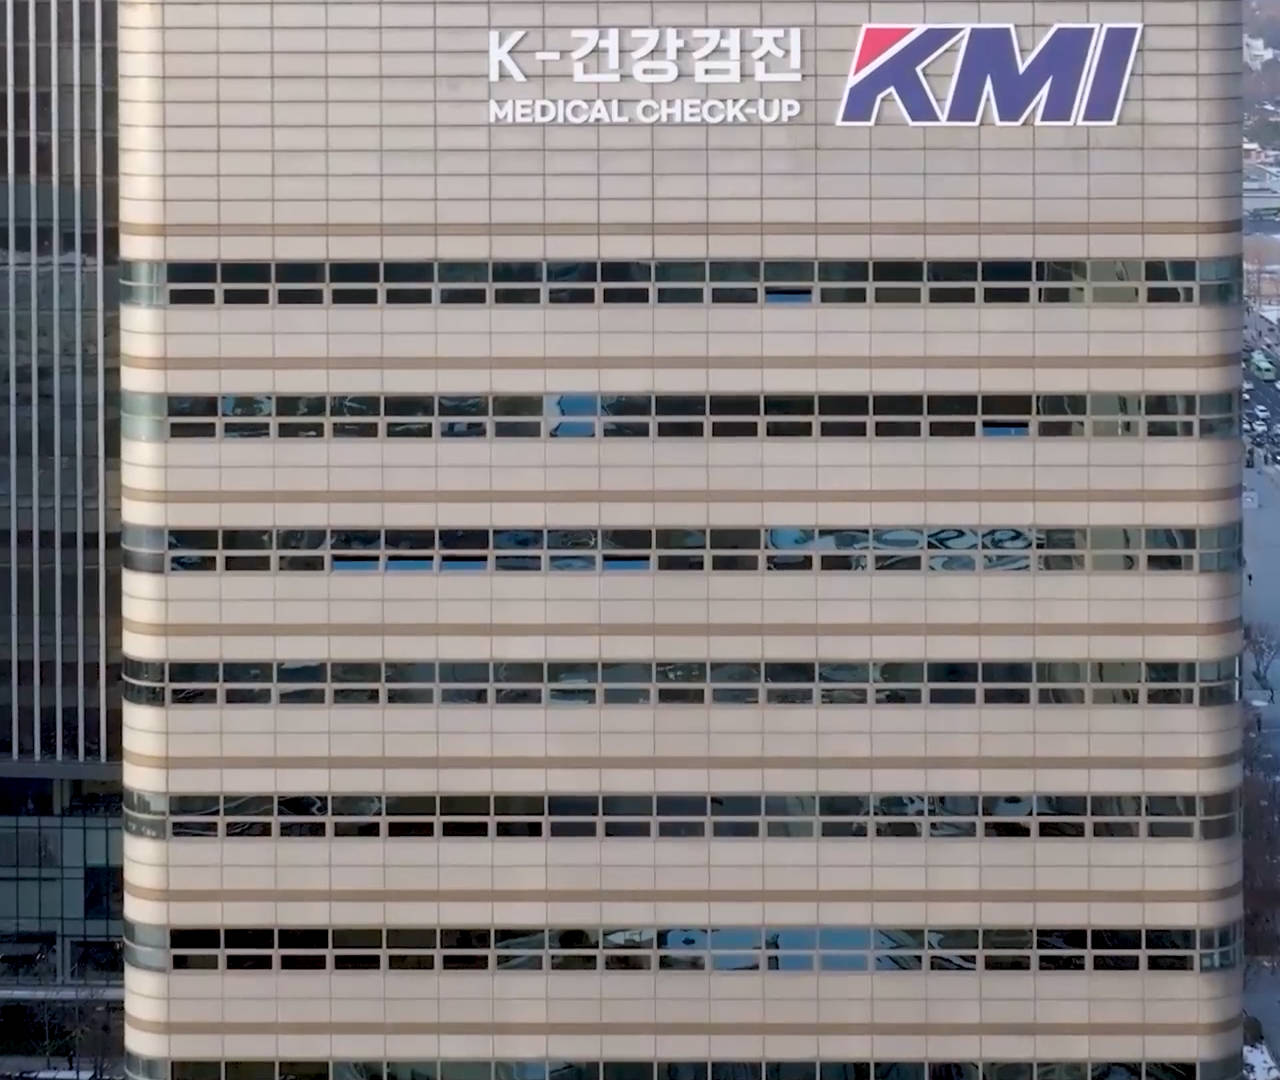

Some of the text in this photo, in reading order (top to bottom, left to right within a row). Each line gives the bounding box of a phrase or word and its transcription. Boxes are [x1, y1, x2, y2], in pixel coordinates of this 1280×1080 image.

[488, 27, 803, 83] K-건강검진
[835, 23, 1144, 126] KMI
[489, 98, 801, 124] MEDICAL CHECK-UP
